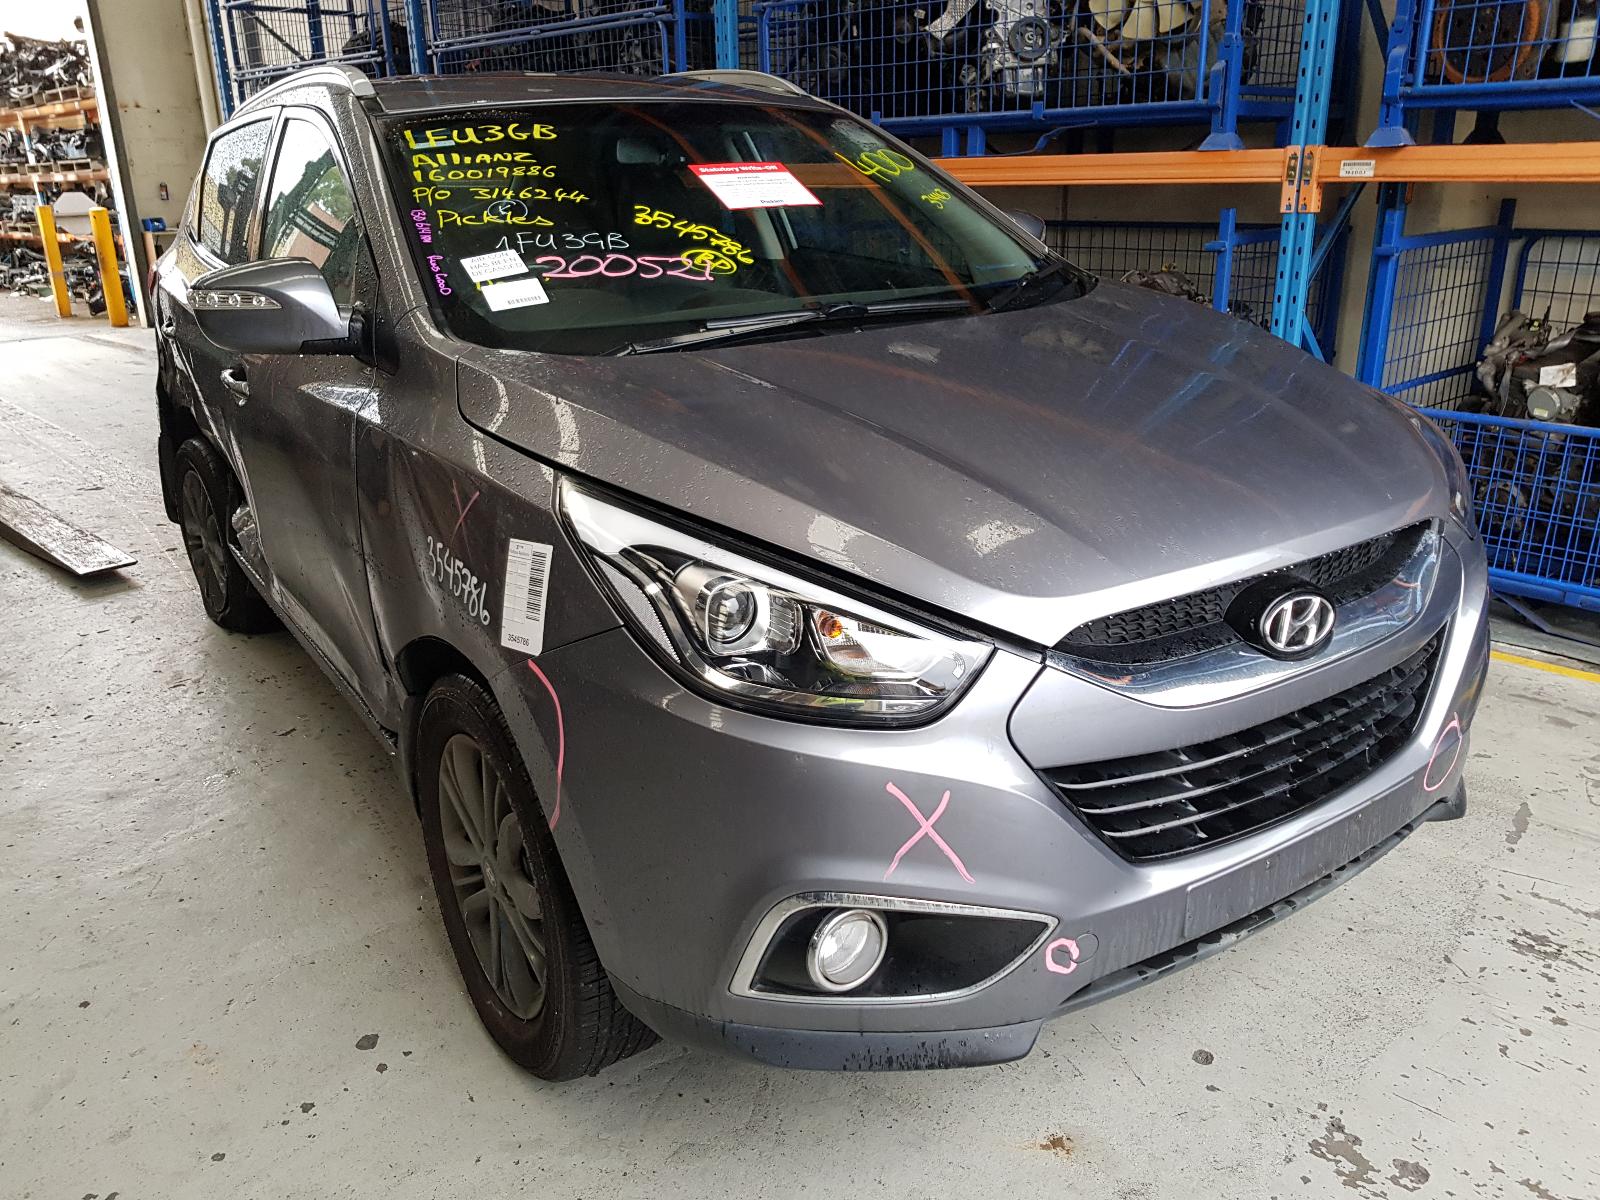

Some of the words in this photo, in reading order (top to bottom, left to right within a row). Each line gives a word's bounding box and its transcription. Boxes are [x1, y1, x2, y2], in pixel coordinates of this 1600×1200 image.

[469, 187, 591, 203] 3146244
[634, 205, 754, 265] 3545786
[427, 536, 490, 626] 3545786
[507, 632, 530, 648] 3545786
